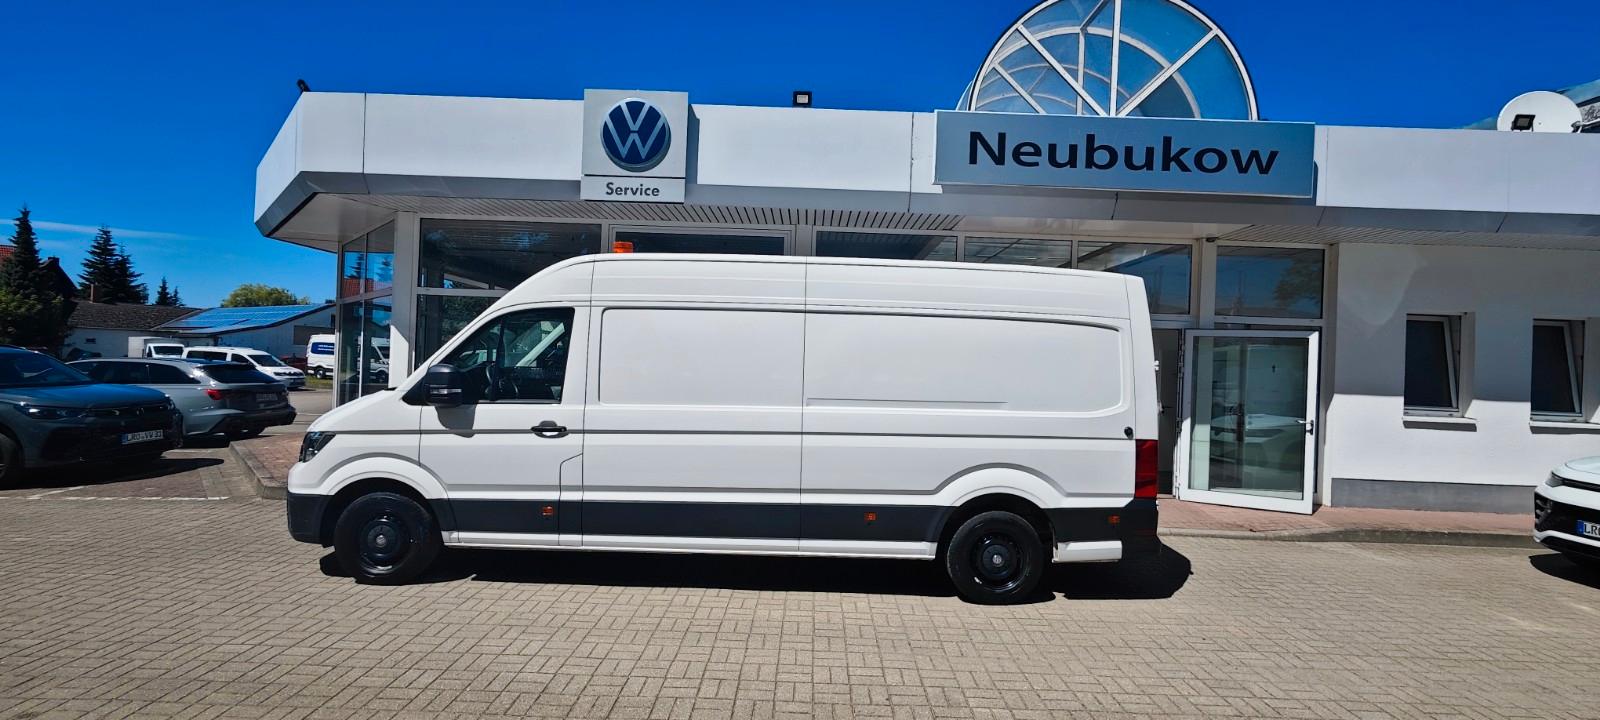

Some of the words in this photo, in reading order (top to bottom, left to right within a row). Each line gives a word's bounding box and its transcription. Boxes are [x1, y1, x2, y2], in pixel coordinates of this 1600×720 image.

[602, 99, 669, 164] VW
[968, 131, 1279, 175] Neubukow
[605, 181, 660, 197] Service
